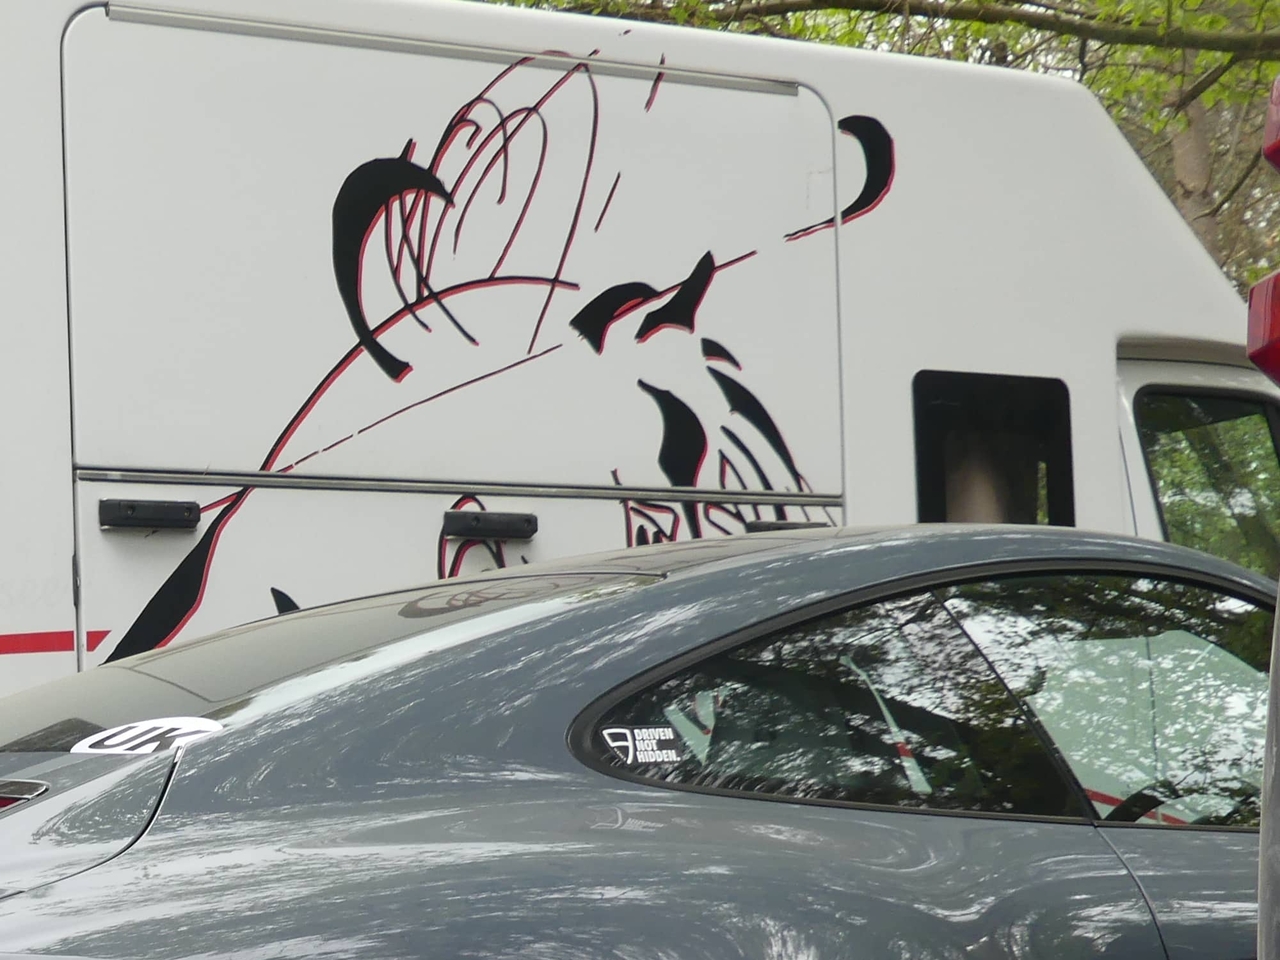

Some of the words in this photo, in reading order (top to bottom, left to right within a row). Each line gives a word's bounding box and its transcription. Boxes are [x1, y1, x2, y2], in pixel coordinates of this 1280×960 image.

[88, 725, 212, 752] UK
[633, 728, 674, 740] DRIVEN
[635, 739, 658, 751] NOT
[636, 749, 681, 763] HIDDEN.
